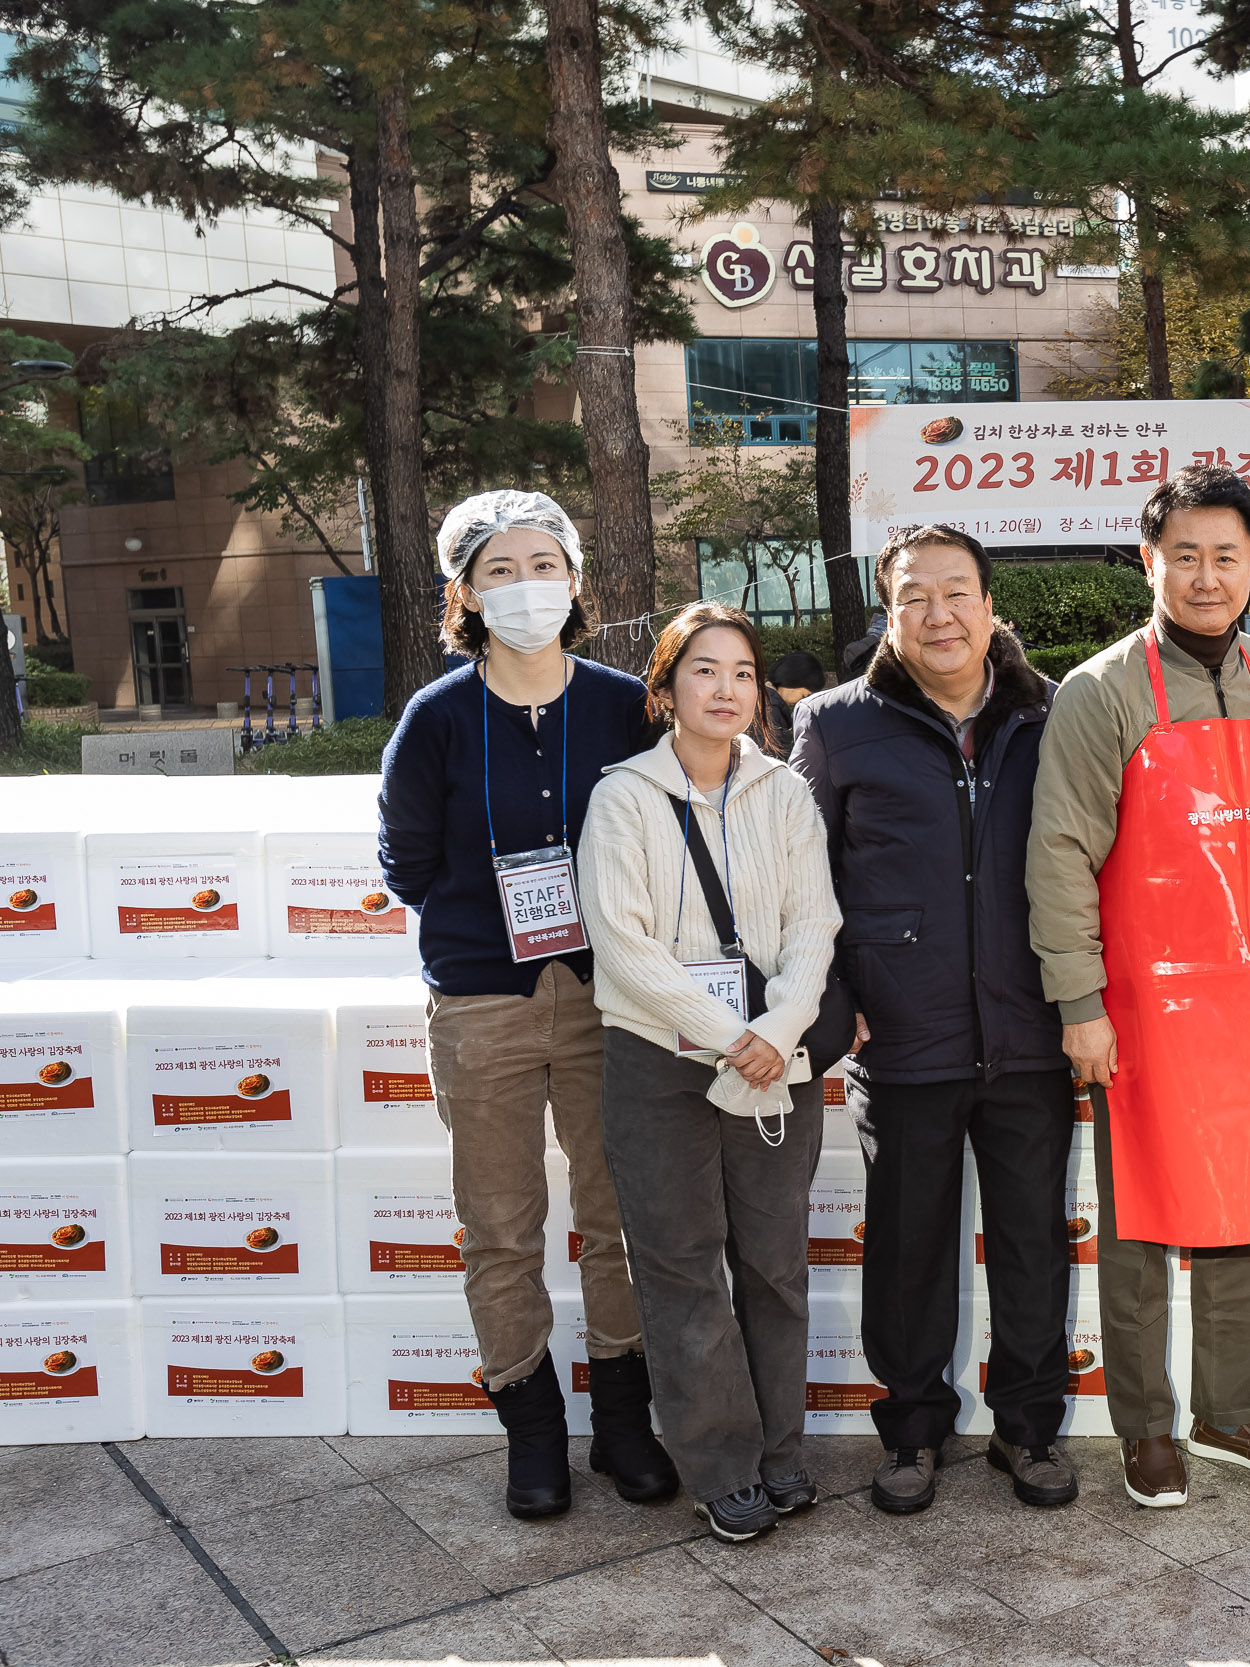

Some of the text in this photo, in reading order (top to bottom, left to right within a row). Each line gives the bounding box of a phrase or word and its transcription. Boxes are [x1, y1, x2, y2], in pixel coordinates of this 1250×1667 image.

[970, 378, 1010, 392] 4650
[974, 422, 1167, 440] 김치 한상자로 전하는 안부
[912, 452, 1034, 492] 2023
[1050, 447, 1169, 491] 제1회
[975, 520, 995, 534] 11.
[999, 518, 1042, 534] 20(월)
[1188, 812, 1210, 826] 광진
[1212, 808, 1243, 822] 사랑의
[120, 875, 230, 886] 2023 제1회 광진 사랑의 김장축제
[513, 884, 566, 907] STAFF
[514, 900, 573, 924] 진행요원
[527, 928, 570, 944] 광진복지재단
[708, 980, 736, 997] AFF
[366, 1038, 426, 1048] 2023 제1회 광진
[18, 1046, 45, 1056] 사랑의
[47, 1045, 83, 1056] 김장축제
[155, 1057, 281, 1071] 2023 제1회 광진 사랑의 김장축제
[14, 1209, 97, 1219] 광진 사랑의 김장축제
[817, 1203, 861, 1213] 광진 사랑의
[164, 1212, 290, 1222] 2023 제1회 광진 사랑의 김장축제
[373, 1210, 455, 1219] 2023 제1회 광진 사랑
[5, 1335, 88, 1347] 광진 사랑의 김장축제
[171, 1334, 296, 1345] 2023 제1회 광진 사랑의 김장축제
[392, 1348, 479, 1358] 2023 제1회 광진 사랑의
[816, 1349, 856, 1359] 제1회 광진
